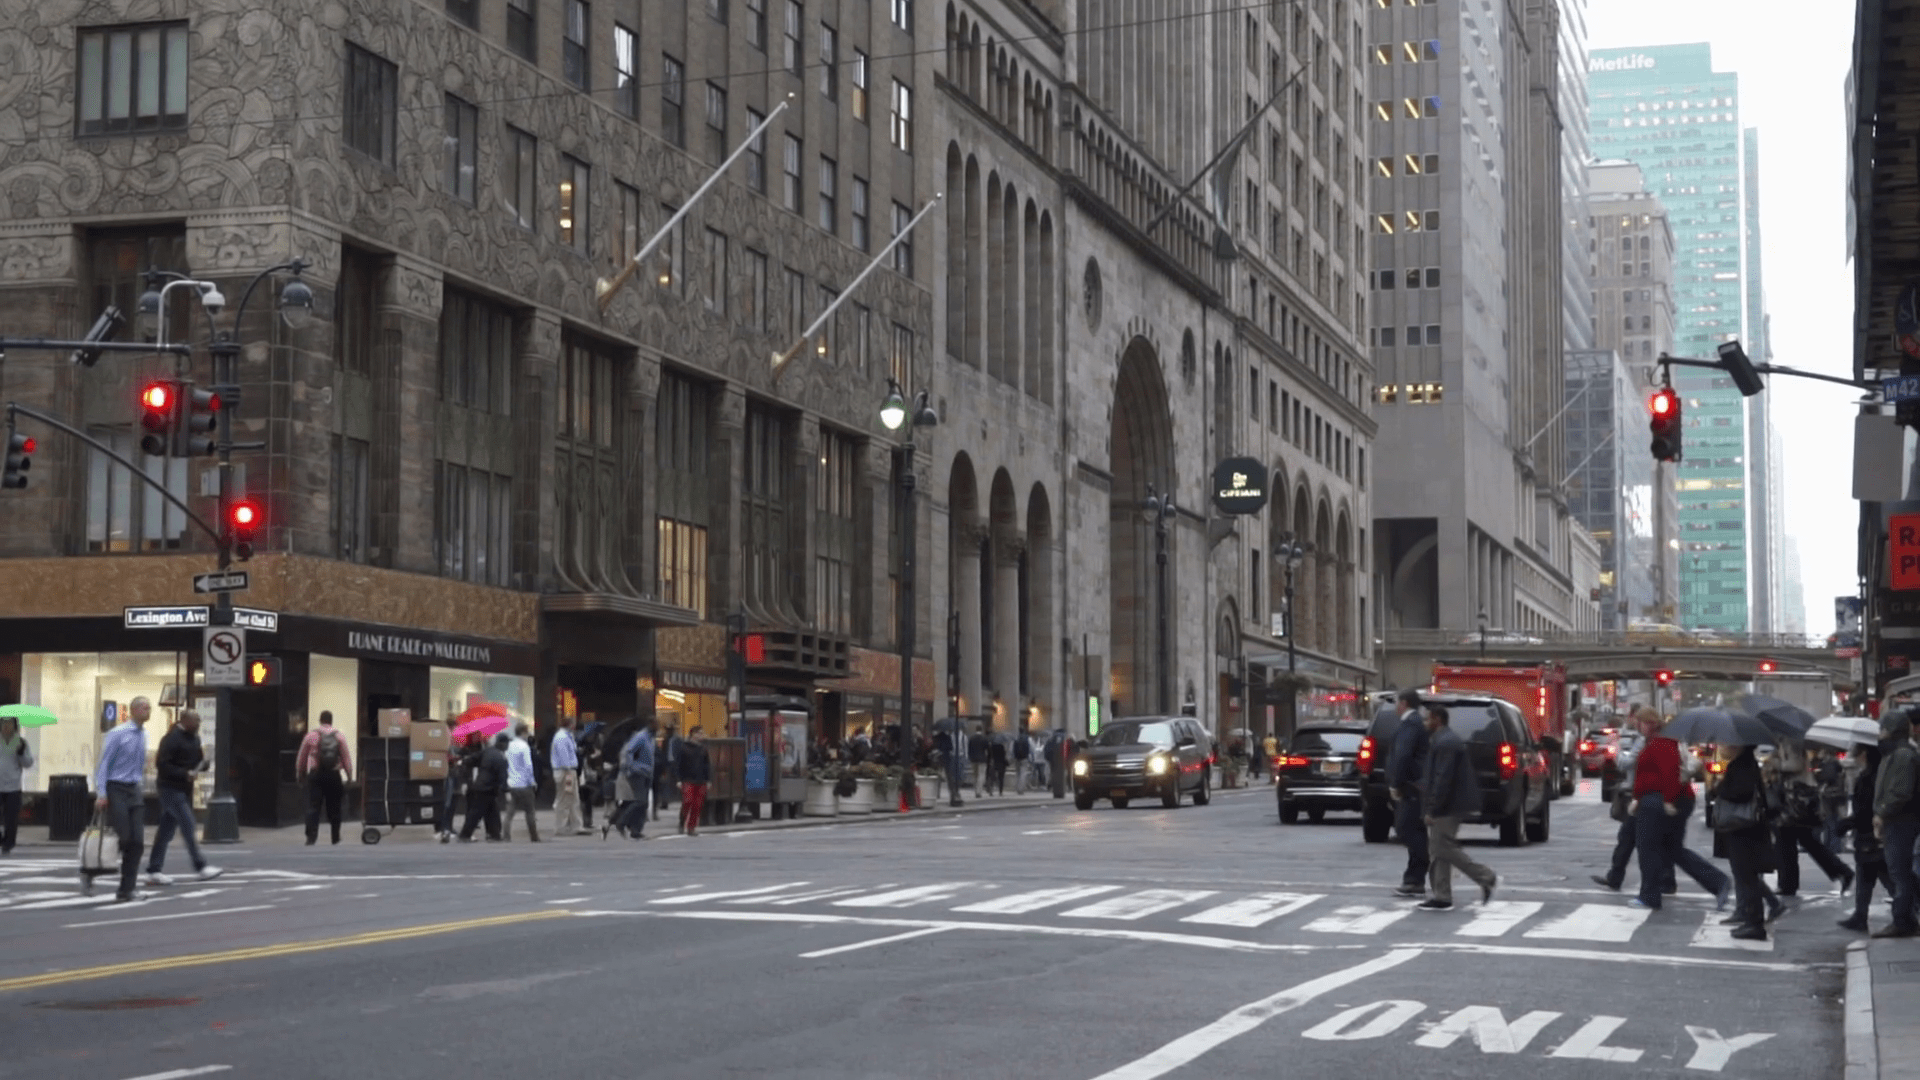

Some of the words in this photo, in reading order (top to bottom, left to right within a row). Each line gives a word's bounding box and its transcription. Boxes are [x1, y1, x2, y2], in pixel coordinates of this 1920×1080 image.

[1589, 54, 1655, 71] MetLife
[1886, 379, 1918, 399] M42
[127, 611, 183, 626] Lexington
[185, 610, 207, 623] Ave
[348, 631, 385, 652] DUANE
[387, 635, 421, 656] READE
[434, 641, 490, 664] WALGREENS
[1301, 1000, 1777, 1072] ONLY
